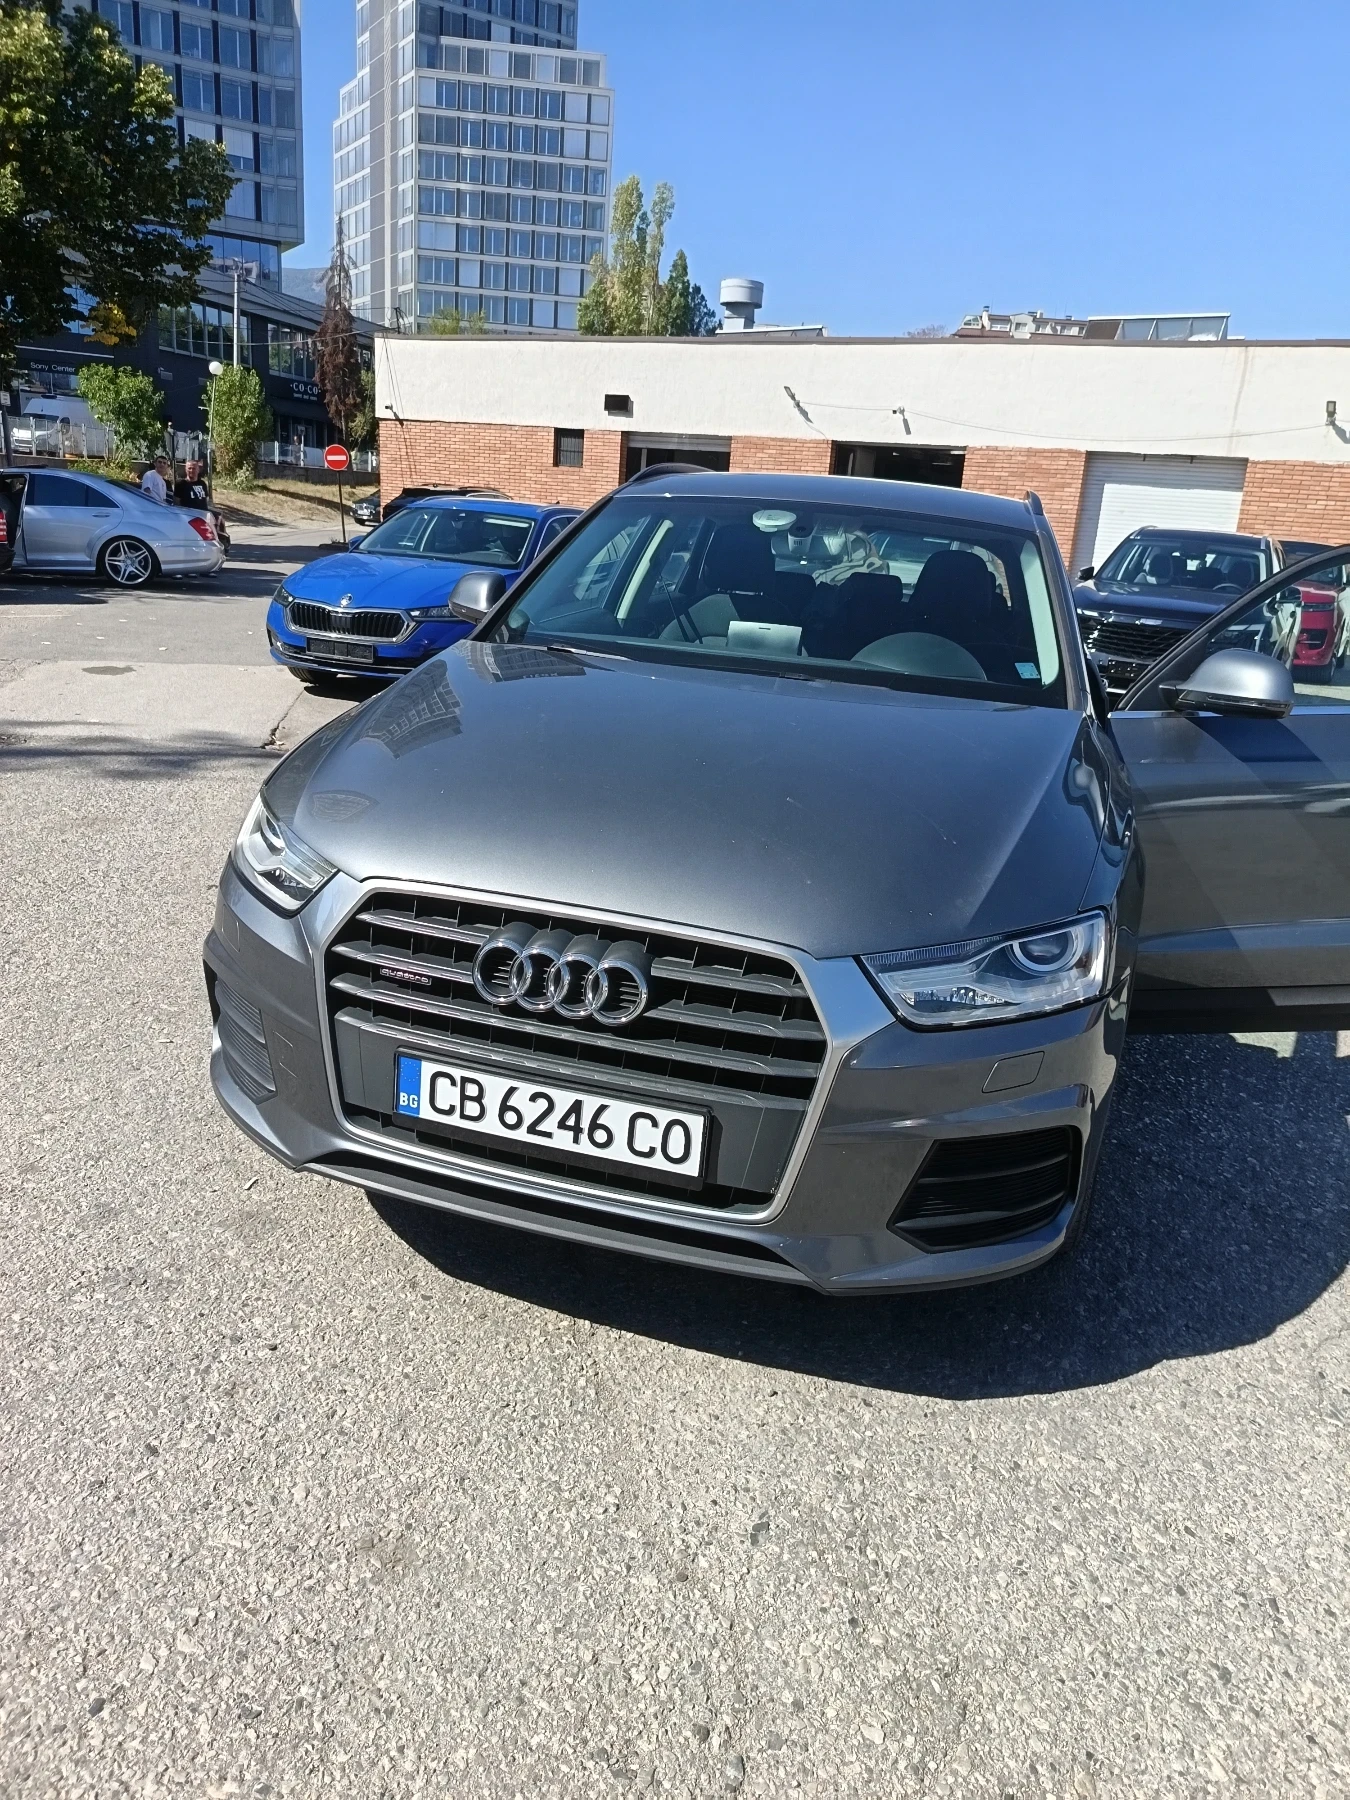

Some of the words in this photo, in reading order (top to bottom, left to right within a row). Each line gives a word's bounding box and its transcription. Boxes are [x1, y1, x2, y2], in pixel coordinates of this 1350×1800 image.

[30, 361, 48, 371] Sony
[51, 364, 76, 373] Center
[381, 968, 429, 983] quattro
[399, 1091, 419, 1109] BG
[429, 1070, 488, 1123] CB
[497, 1085, 616, 1150] 6246
[626, 1111, 693, 1165] CO
